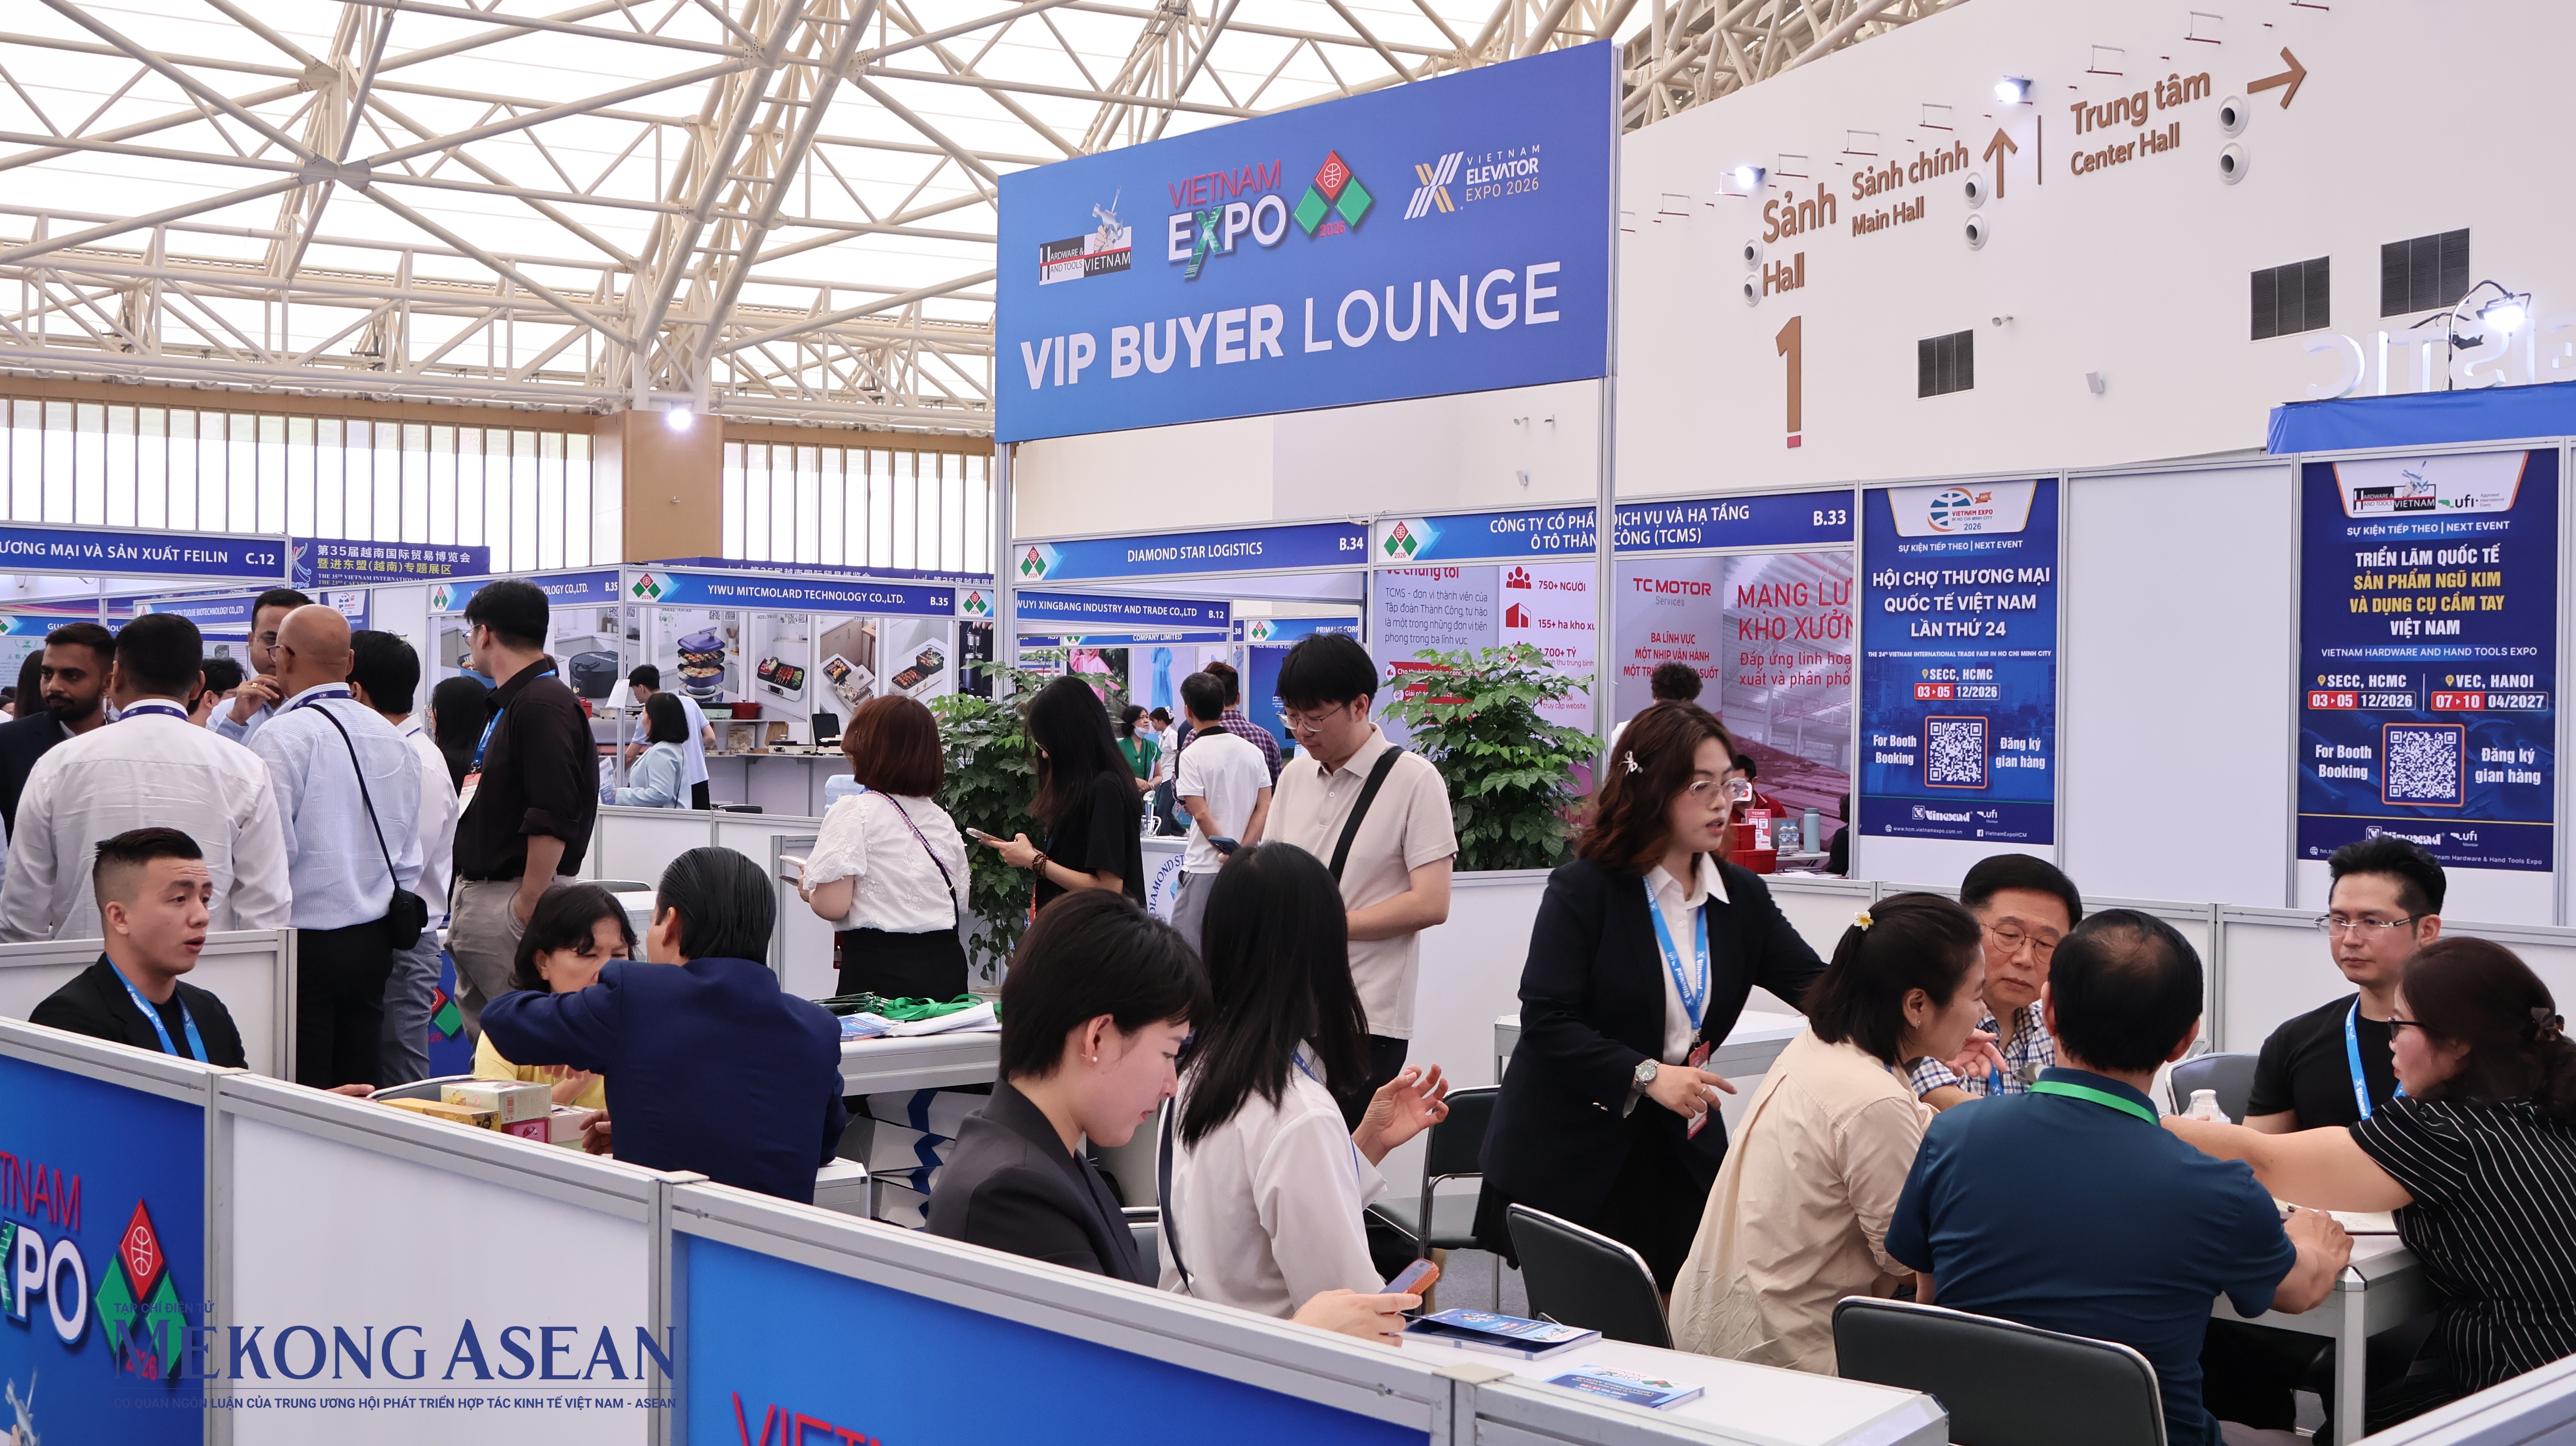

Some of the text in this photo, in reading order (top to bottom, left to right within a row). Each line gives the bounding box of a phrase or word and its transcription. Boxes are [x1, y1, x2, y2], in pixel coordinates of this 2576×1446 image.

[2071, 72, 2210, 135] Trung tâm
[1467, 144, 1540, 166] VIETNAM
[2070, 122, 2179, 175] Center Hall
[1467, 158, 1539, 185] ELEVATOR
[1852, 140, 1968, 200] Sảnh chính
[1168, 159, 1280, 208] VIETNAM
[1466, 177, 1539, 202] EXPO 2026
[1762, 182, 1837, 243] Sảnh
[1852, 196, 1924, 237] Main Hall
[1168, 194, 1286, 279] EXPO
[1319, 221, 1346, 237] 2026
[1084, 252, 1130, 272] VIETNAM
[1762, 252, 1804, 297] Hall
[1021, 261, 1561, 390] VIP BUYER LOUNGE
[1775, 315, 1801, 433] 1
[1490, 503, 1749, 533] CÔNG TY CỔ VỤ VÀ HẠ TẦNG
[1814, 510, 1846, 526] B.33
[1531, 528, 1701, 549] Ô TÔ CÔNG (TCMS)
[51, 543, 274, 565] MẠI VÀ SẢN XUẤT FEILIN C.12
[317, 544, 471, 563] 第35届越南国际贸易博览会
[1127, 537, 1364, 562] DIAMOND STAR LOGISTICS B.34
[2355, 543, 2501, 567] TRIỂN LÃM QUỐC TẾ
[1539, 580, 1586, 592] 750+ NGƯỜI
[1633, 578, 1711, 595] TC MOTOR
[1873, 567, 2050, 590] HỘI CHỢ THƯƠNG MẠI
[2354, 568, 2501, 590] SẢN PHẨM NGŨ KIM
[708, 585, 948, 606] YIWU MITCMOLARD TECHNOLOGY CO.,LTD. B.35
[1385, 588, 1487, 602] TCMS đơn vị thành viên của
[1656, 596, 1685, 606] Services
[1738, 583, 1808, 614] MẠNG
[1884, 592, 2036, 614] QUỐC TẾ VIỆT NAM
[2350, 595, 2368, 613] VÀ
[2372, 598, 2412, 615] DỤNG
[2416, 597, 2436, 614] CỤ
[2480, 595, 2505, 611] TAY
[197, 607, 228, 616] BIOTECHNOLOGY
[1016, 599, 1036, 608] WUYI
[1039, 600, 1081, 611] XINGBANG
[1083, 603, 1122, 614] INDUSTRY
[1124, 605, 1141, 614] AND
[1143, 606, 1166, 615] TRADE
[1209, 610, 1224, 619] B.12
[1385, 602, 1398, 614] Tập
[1400, 603, 1418, 613] đoàn
[1421, 605, 1442, 614] Thành
[1466, 608, 1473, 617] tự
[1475, 607, 1488, 616] hào
[1538, 619, 1585, 630] 155+ ha kho
[1739, 617, 1786, 641] KHO
[1911, 618, 2006, 637] LẦN THỨ 24
[2390, 618, 2460, 638] VIỆT NAM
[1385, 633, 1408, 645] phong
[1410, 635, 1429, 645] trong
[1431, 635, 1440, 644] ba
[1441, 635, 1454, 644] lĩnh
[1651, 632, 1695, 647] BA LĨNH VỰC
[2321, 647, 2537, 657] VIETNAM HARDWARE AND HAND TOOLS EXPO
[1930, 668, 1993, 681] SECC, HCMC
[1956, 686, 1997, 698] 12/2026
